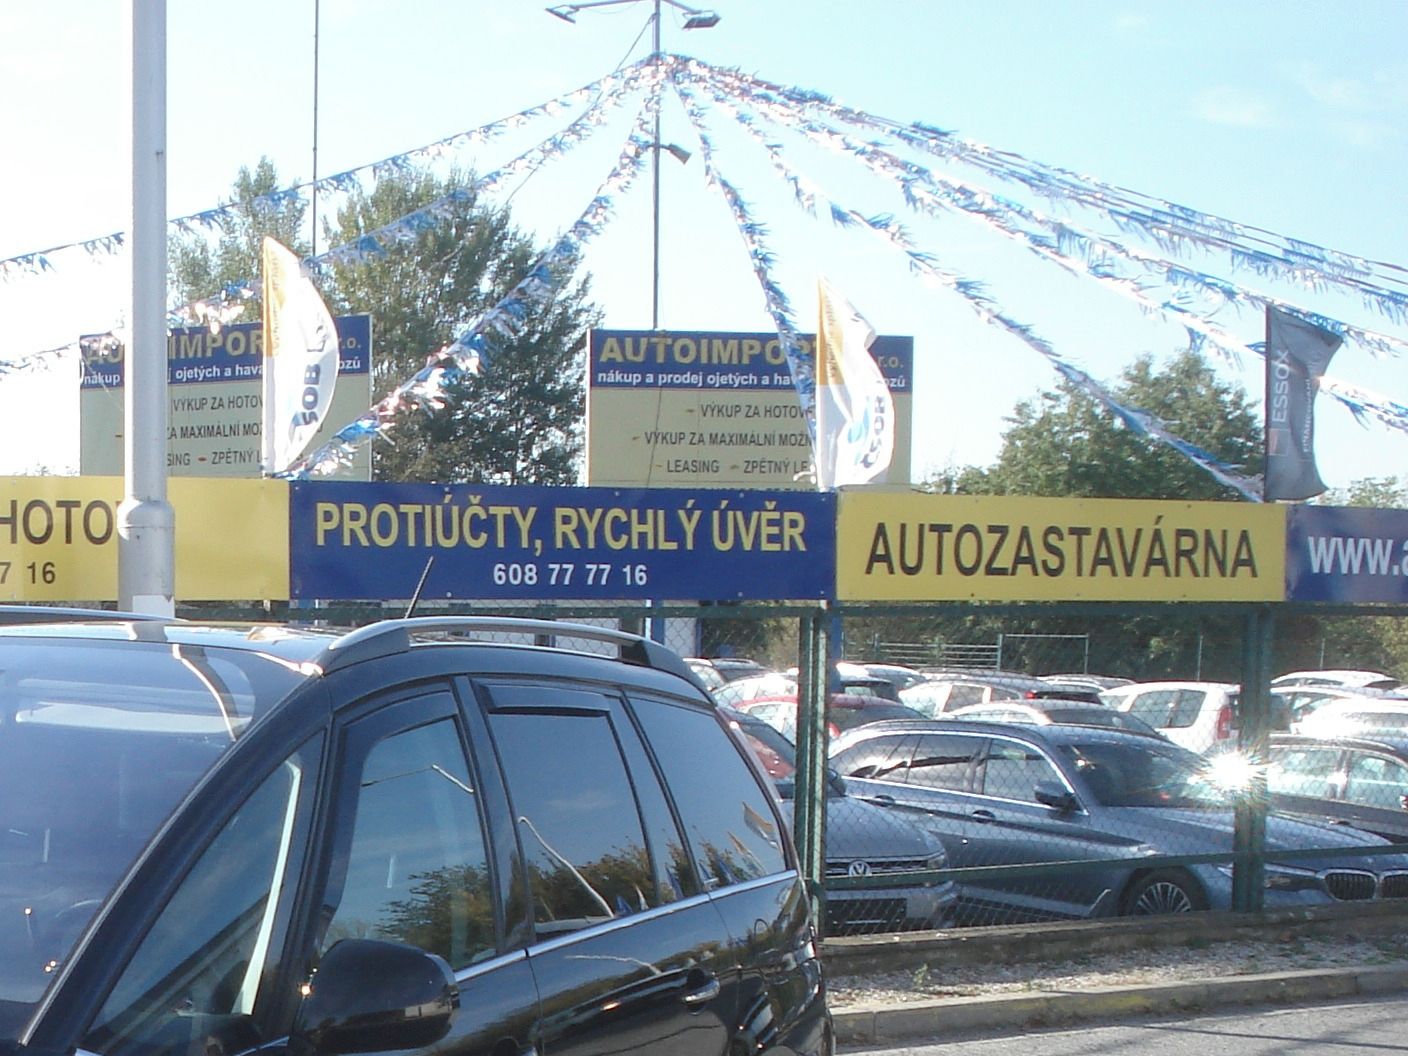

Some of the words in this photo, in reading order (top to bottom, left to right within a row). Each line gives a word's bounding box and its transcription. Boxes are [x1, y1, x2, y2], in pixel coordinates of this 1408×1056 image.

[176, 364, 220, 382] ojetých
[224, 367, 231, 377] a
[598, 371, 641, 387] nákup
[646, 373, 654, 384] a
[659, 371, 703, 387] prodej
[707, 372, 757, 388] ojetých
[762, 375, 770, 385] a
[1272, 350, 1289, 422] ESSOX
[210, 397, 224, 411] ZA
[701, 401, 742, 418] VÝKUP
[745, 405, 760, 417] ZA
[180, 421, 240, 438] MAXIMÁLNÍ
[645, 429, 685, 445] VÝKUP
[689, 432, 705, 445] ZA
[709, 430, 775, 447] MAXIMÁLNÍ
[211, 448, 252, 465] ZPĚTNÝ
[667, 459, 719, 474] LEASING
[744, 457, 789, 474] ZPĚTNÝ
[316, 495, 542, 557] PROTIÚČTY,
[555, 500, 702, 551] RYCHLÝ
[713, 501, 807, 552] ÚVĚR
[865, 515, 1259, 579] AUTOZASTAVÁRNA
[26, 561, 57, 585] 16
[493, 563, 538, 586] 608
[548, 563, 575, 586] 77
[585, 563, 612, 586] 77
[623, 565, 648, 587] 16
